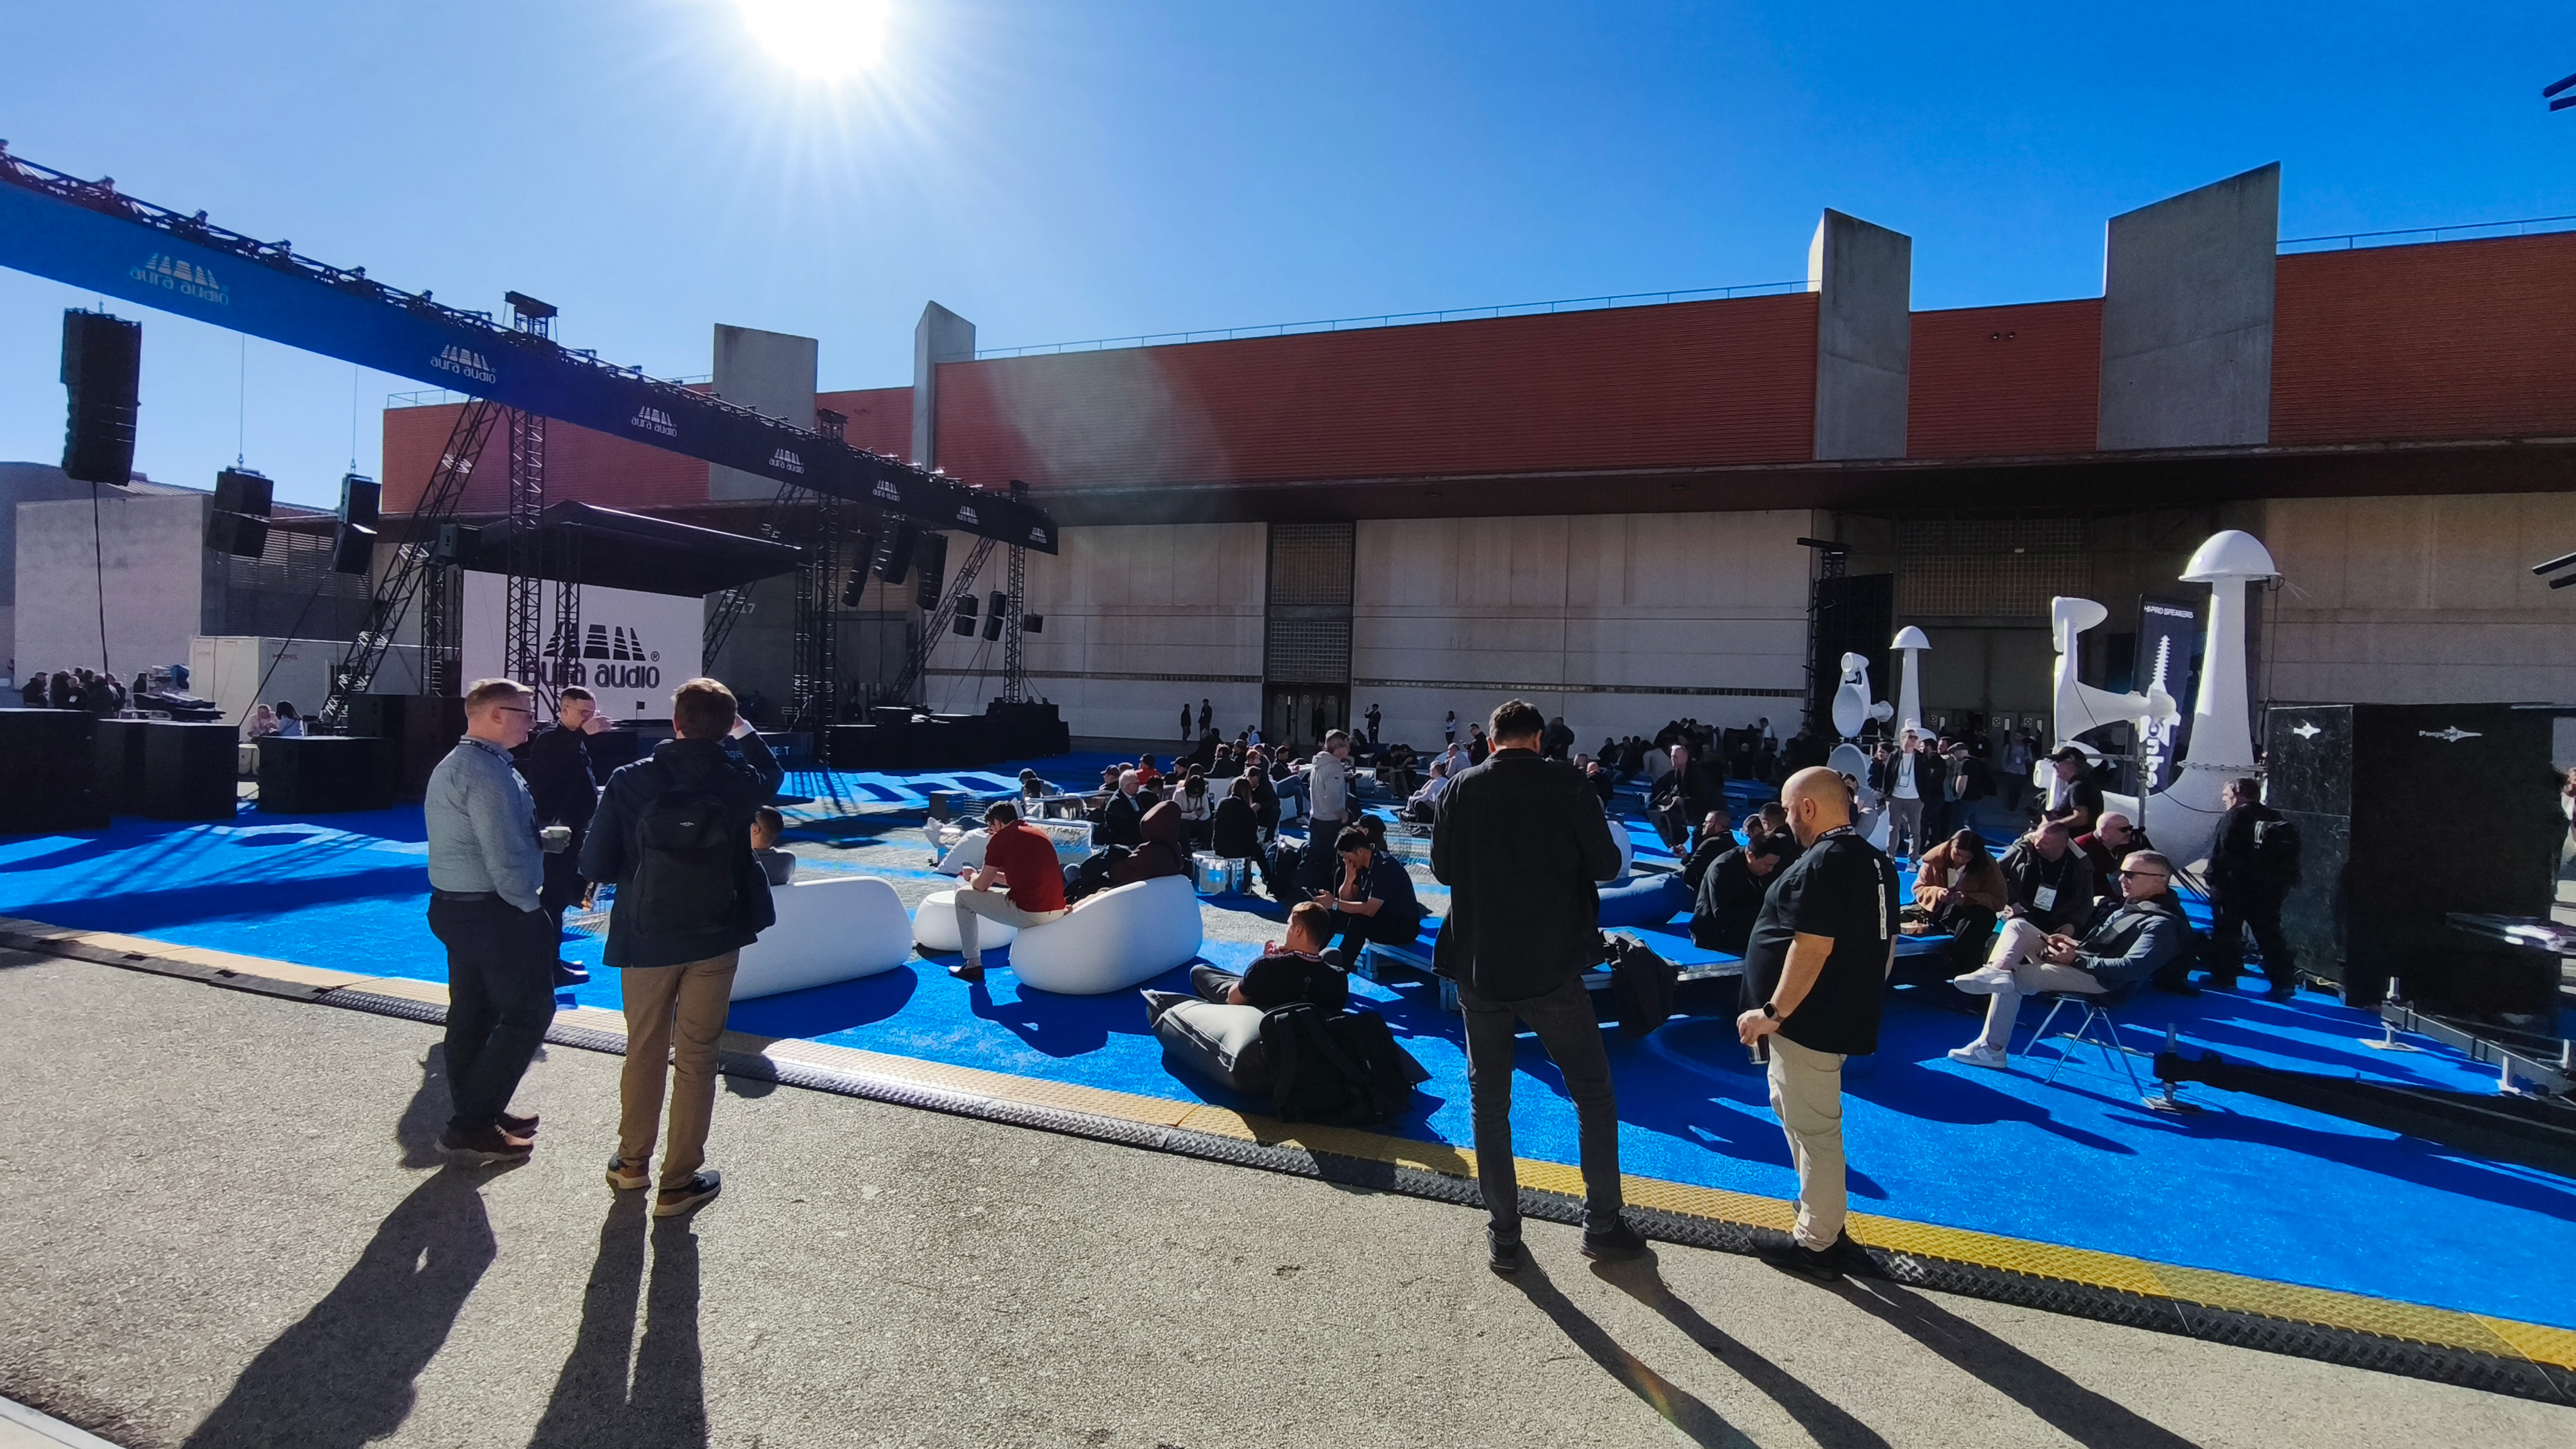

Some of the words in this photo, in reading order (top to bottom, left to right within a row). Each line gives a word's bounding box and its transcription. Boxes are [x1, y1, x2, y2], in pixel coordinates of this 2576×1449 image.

[129, 267, 174, 290] aura
[180, 282, 229, 305] audio
[430, 356, 460, 374] aura
[464, 366, 496, 384] audio
[631, 416, 652, 430] aura
[654, 424, 677, 437] audio
[594, 663, 660, 689] audio
